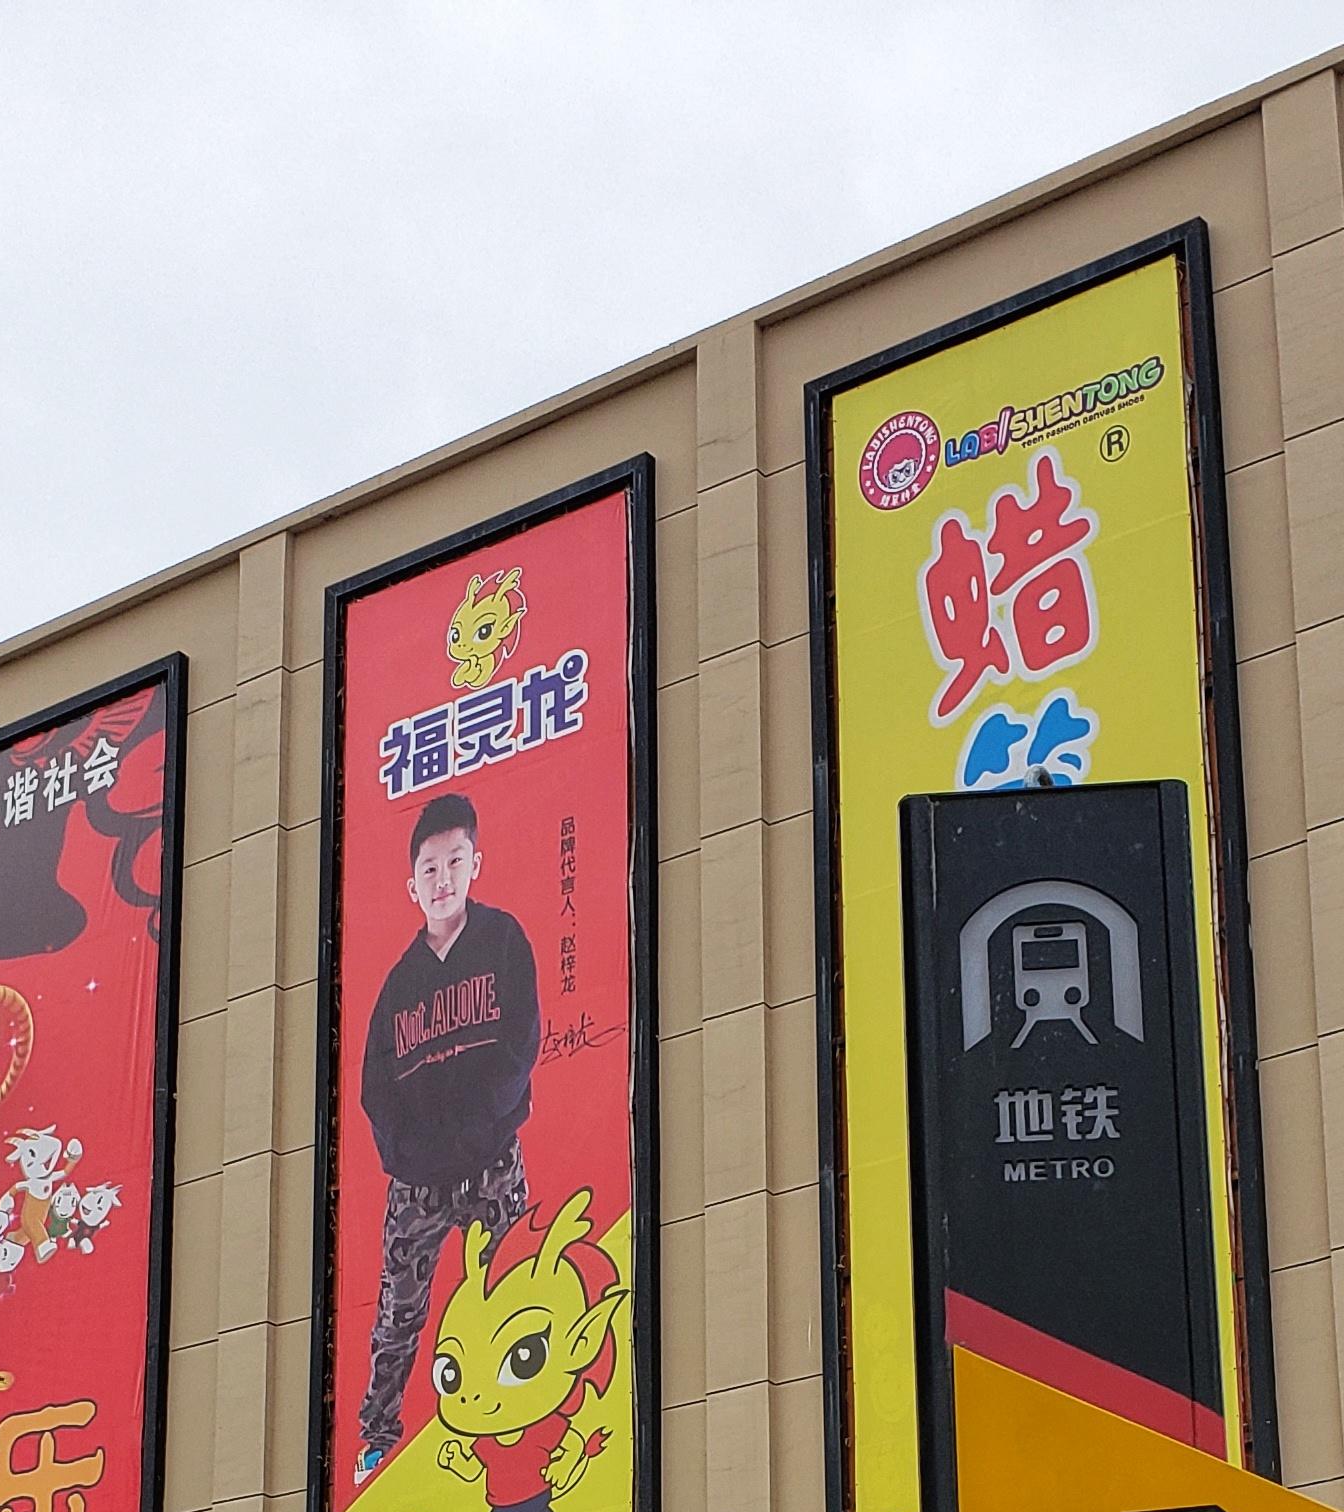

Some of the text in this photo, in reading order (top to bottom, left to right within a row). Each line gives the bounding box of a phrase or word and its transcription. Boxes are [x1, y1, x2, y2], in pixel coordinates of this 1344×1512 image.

[379, 646, 590, 801] 福灵龙
[993, 1084, 1122, 1144] 地铁
[1003, 1156, 1116, 1183] METRO
